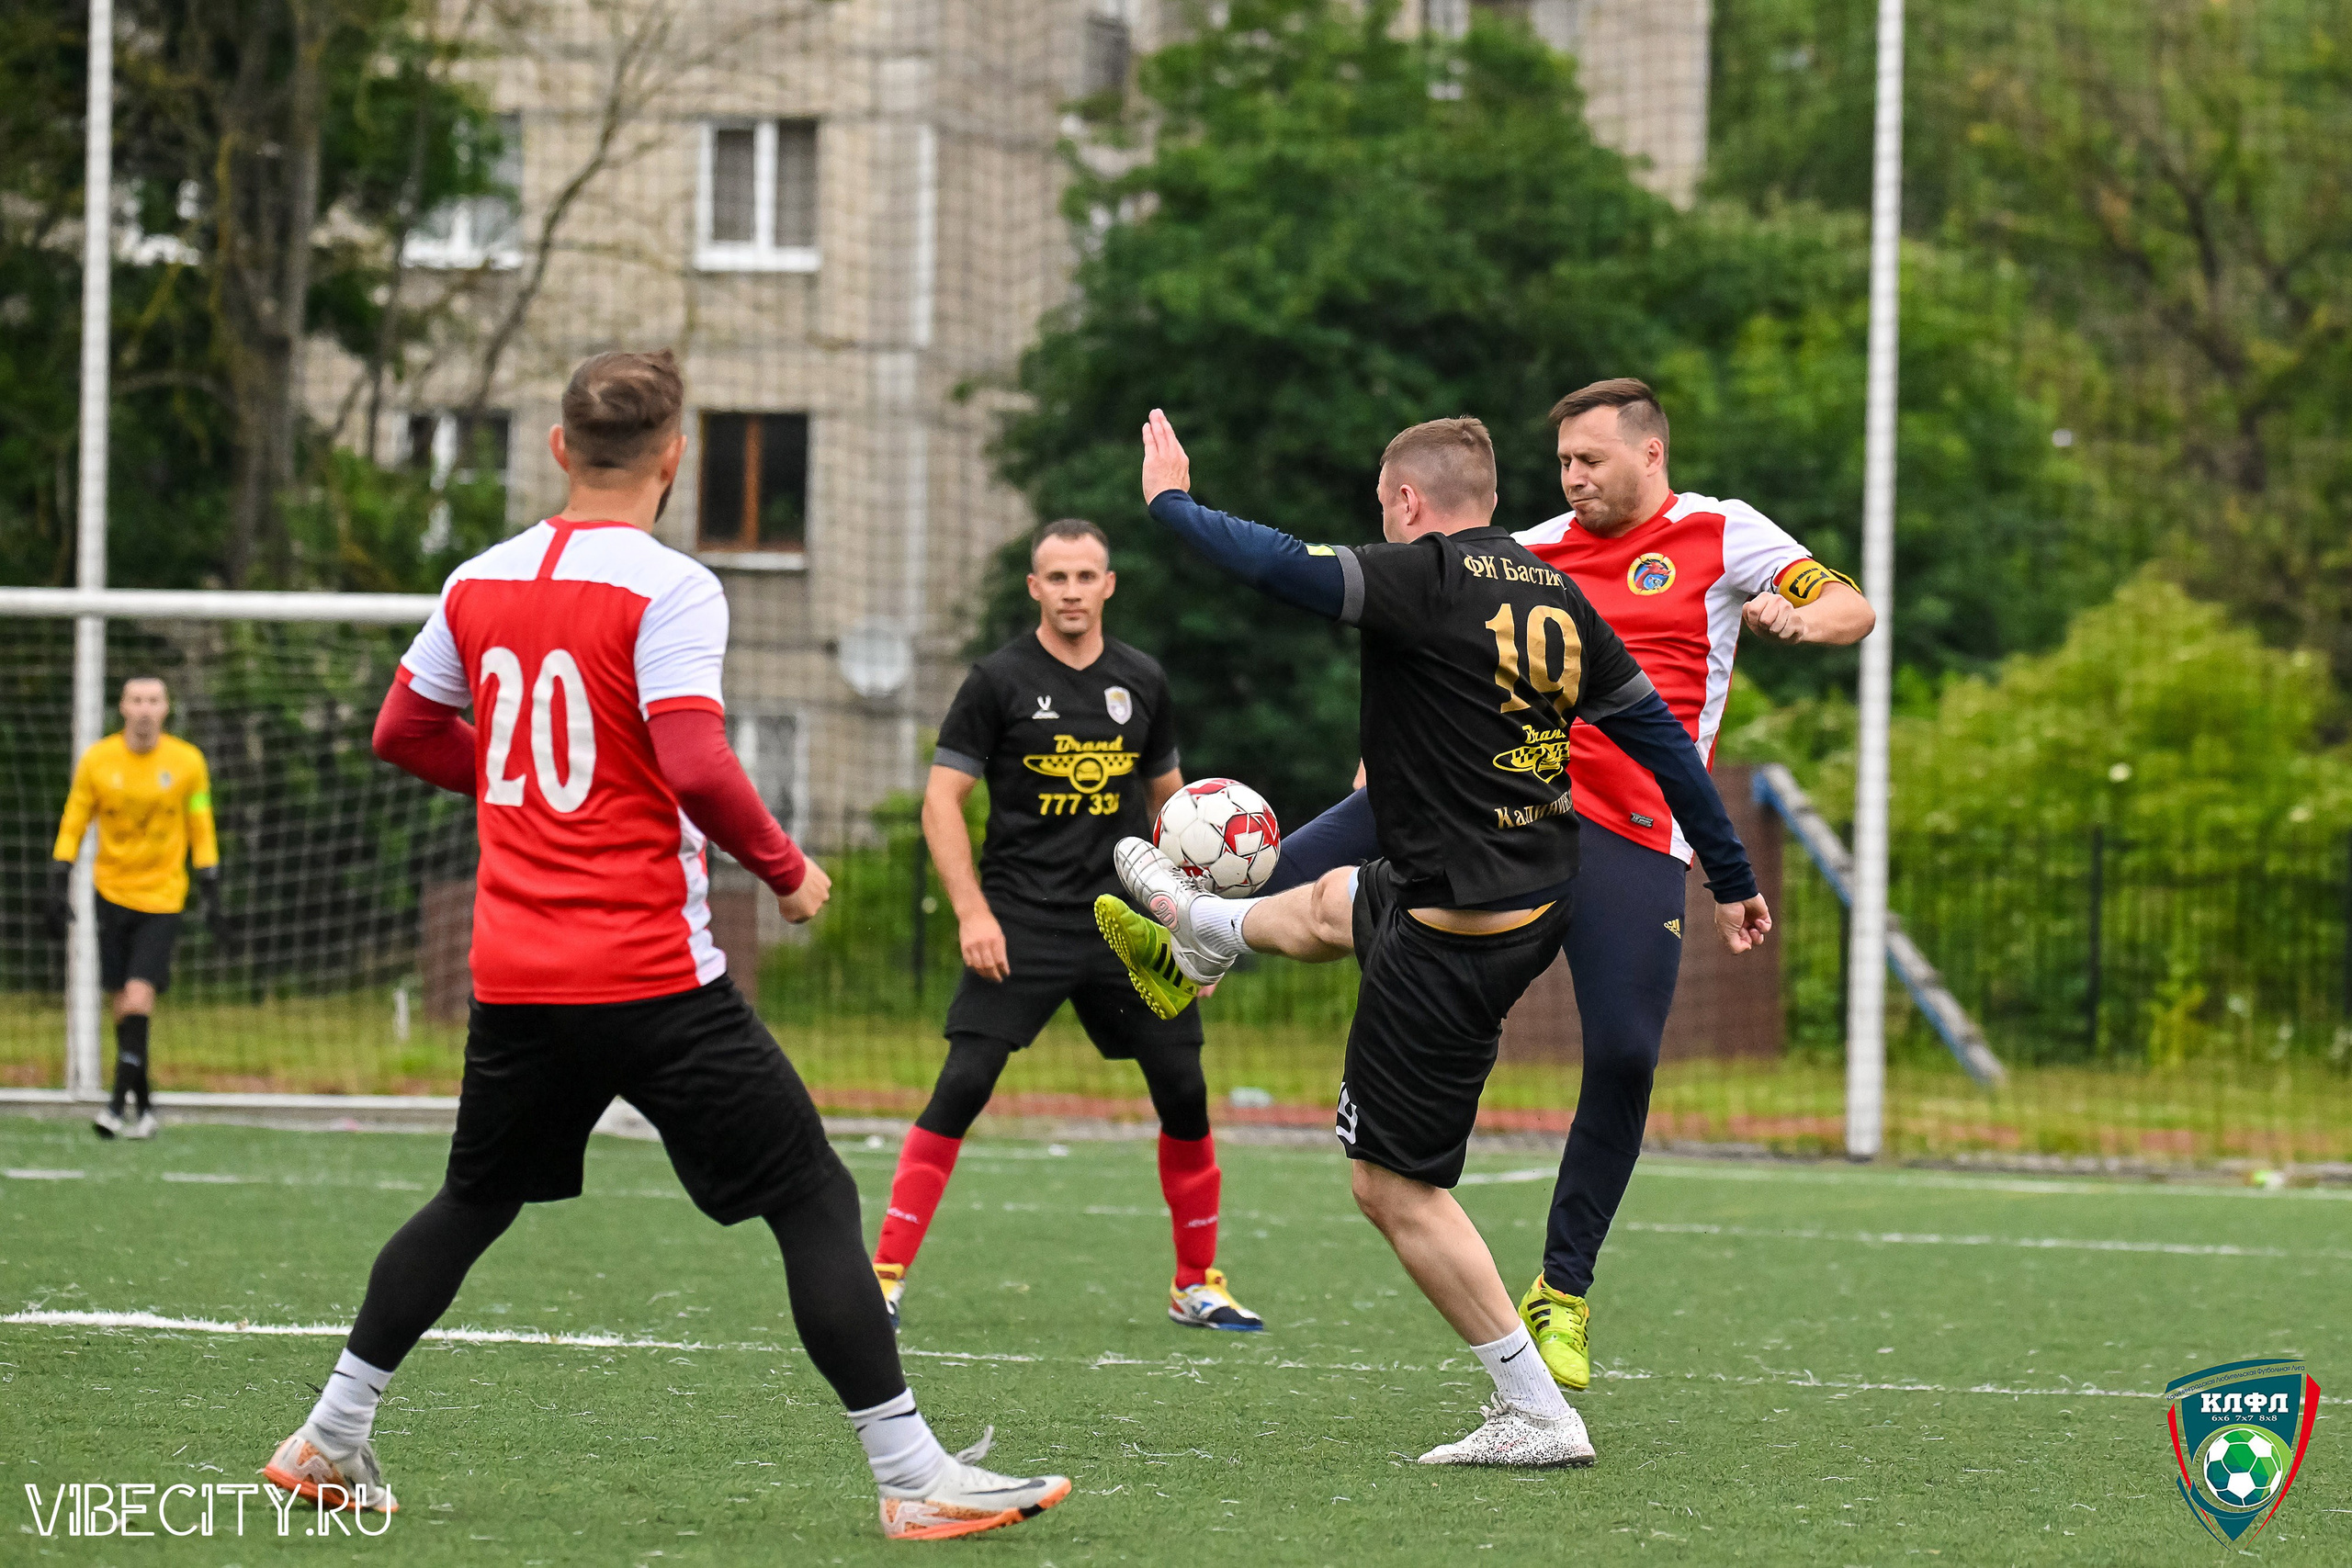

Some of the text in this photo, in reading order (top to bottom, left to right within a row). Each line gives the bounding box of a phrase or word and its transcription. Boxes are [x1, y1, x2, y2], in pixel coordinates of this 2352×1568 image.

[1463, 554, 1566, 590] ФК Басти
[480, 646, 596, 814] 20
[1053, 734, 1124, 754] Brand
[1037, 793, 1082, 816] 777
